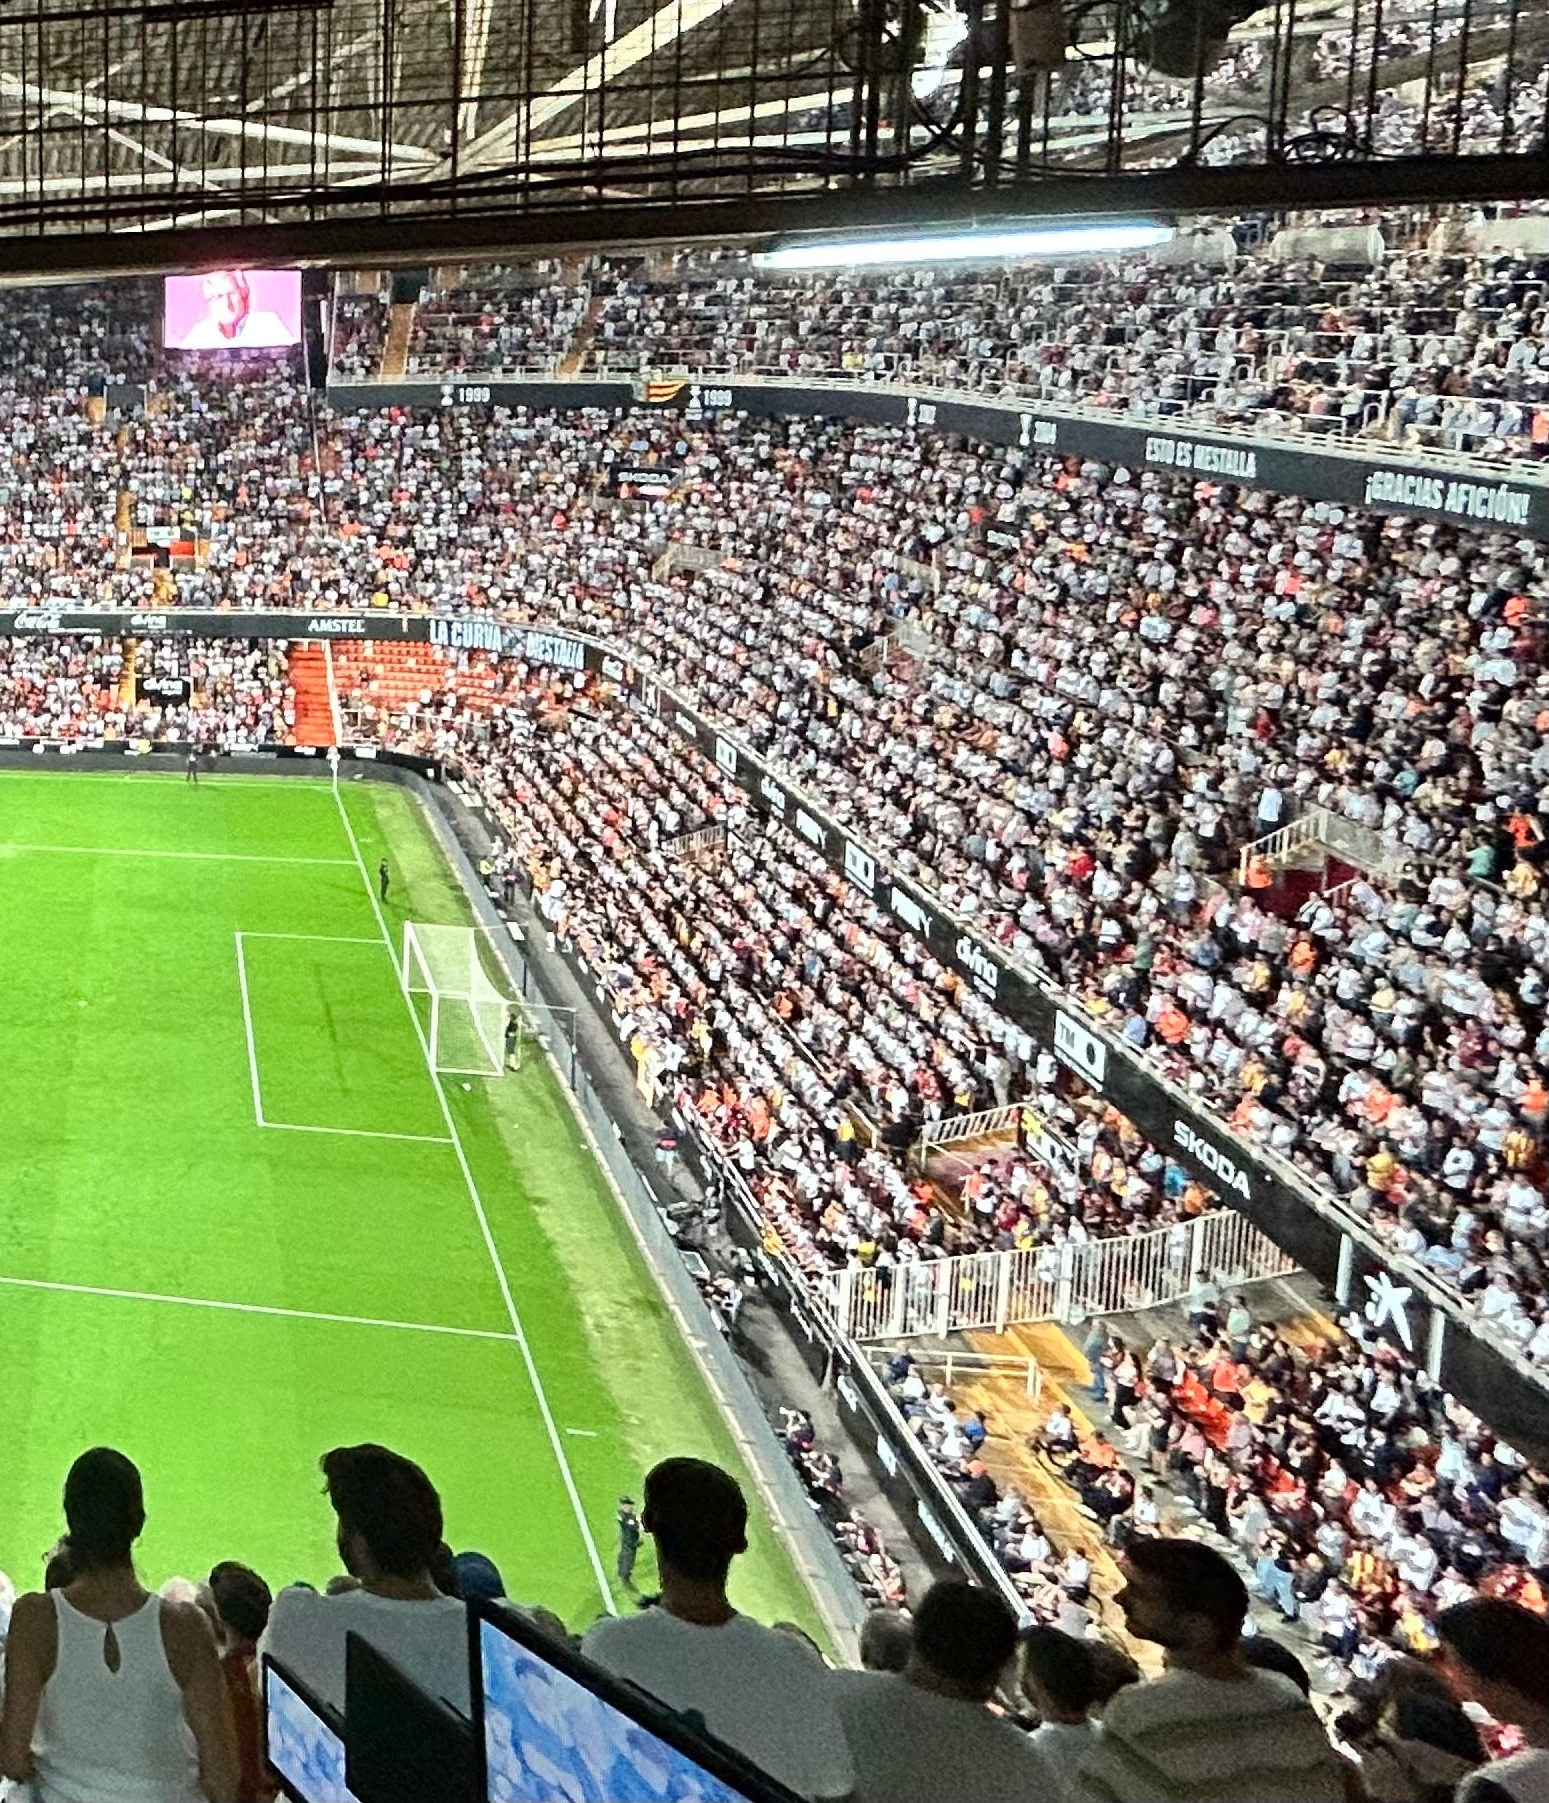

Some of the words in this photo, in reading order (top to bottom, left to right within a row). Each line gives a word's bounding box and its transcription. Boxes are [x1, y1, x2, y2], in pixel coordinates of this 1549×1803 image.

[459, 387, 490, 403] 1999
[1176, 441, 1192, 467] ES
[1193, 444, 1257, 478] MESTALLA
[1365, 471, 1444, 510] ¡GRACIAS
[308, 618, 365, 633] AMSTEL
[429, 619, 449, 646] LA
[450, 622, 503, 653] CURVA
